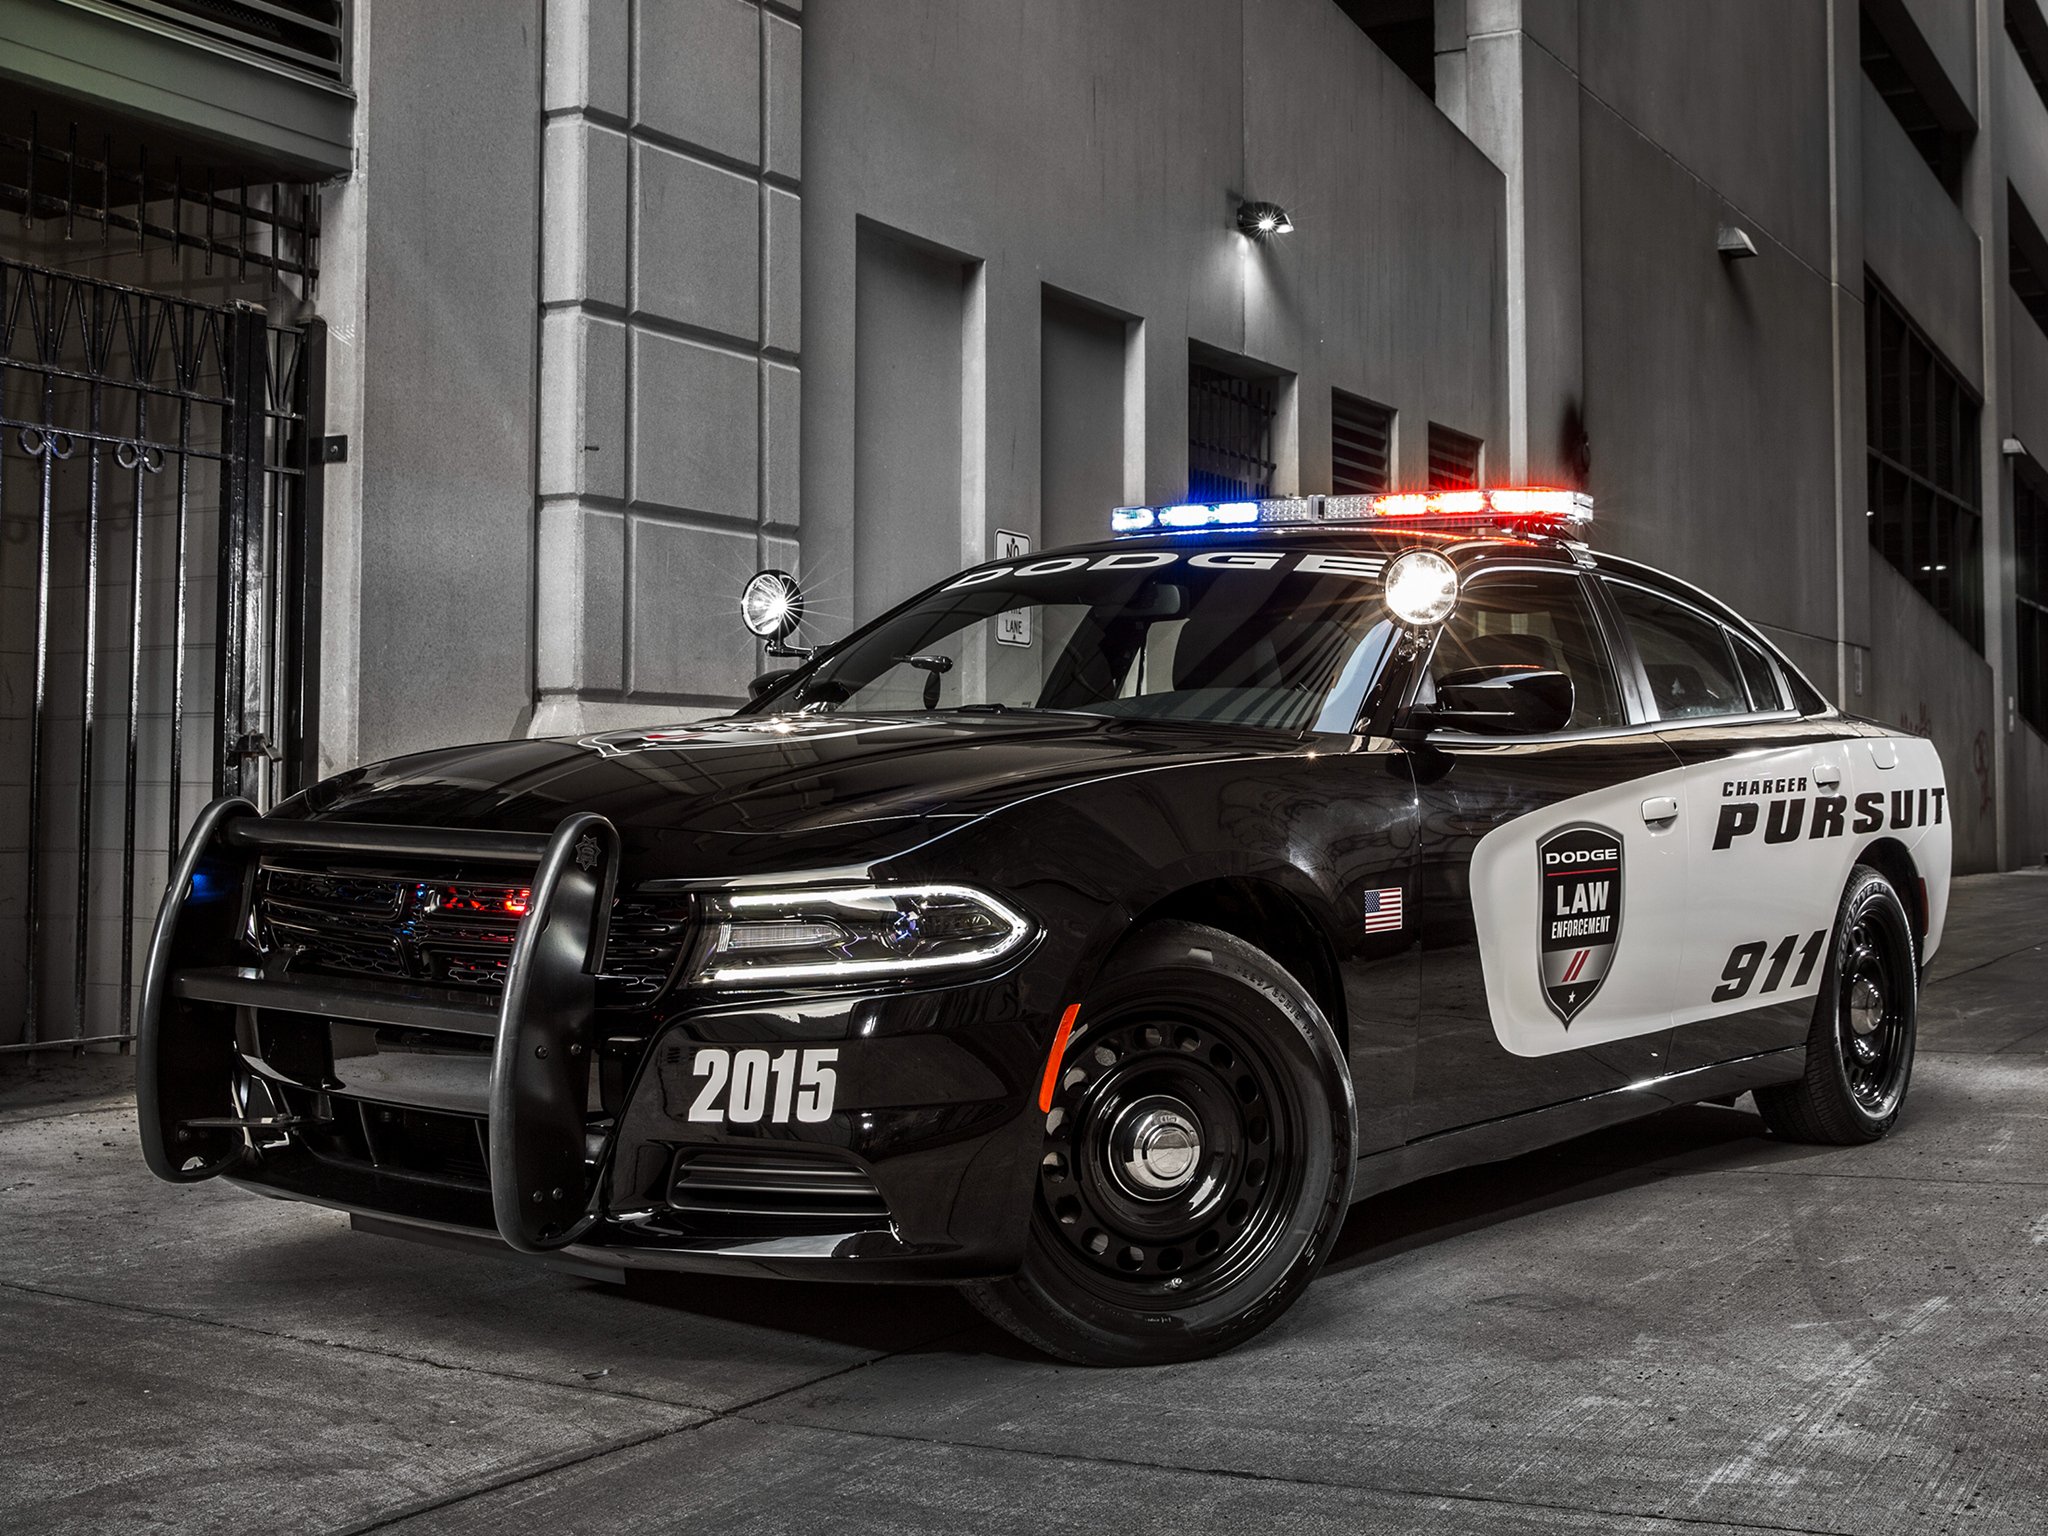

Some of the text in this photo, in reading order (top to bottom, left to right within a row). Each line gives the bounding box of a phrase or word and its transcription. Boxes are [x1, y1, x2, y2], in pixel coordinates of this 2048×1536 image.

[1006, 542, 1020, 559] NO
[940, 552, 1388, 592] DODGE
[1005, 619, 1022, 635] LANE
[1722, 777, 1807, 797] CHARGER
[1712, 787, 1945, 850] PURSUIT
[1545, 848, 1617, 865] DODGE
[1556, 880, 1610, 916] LAW
[1551, 915, 1611, 939] ENFORCEMENT
[1711, 929, 1828, 1003] 911
[688, 1048, 839, 1123] 2015
